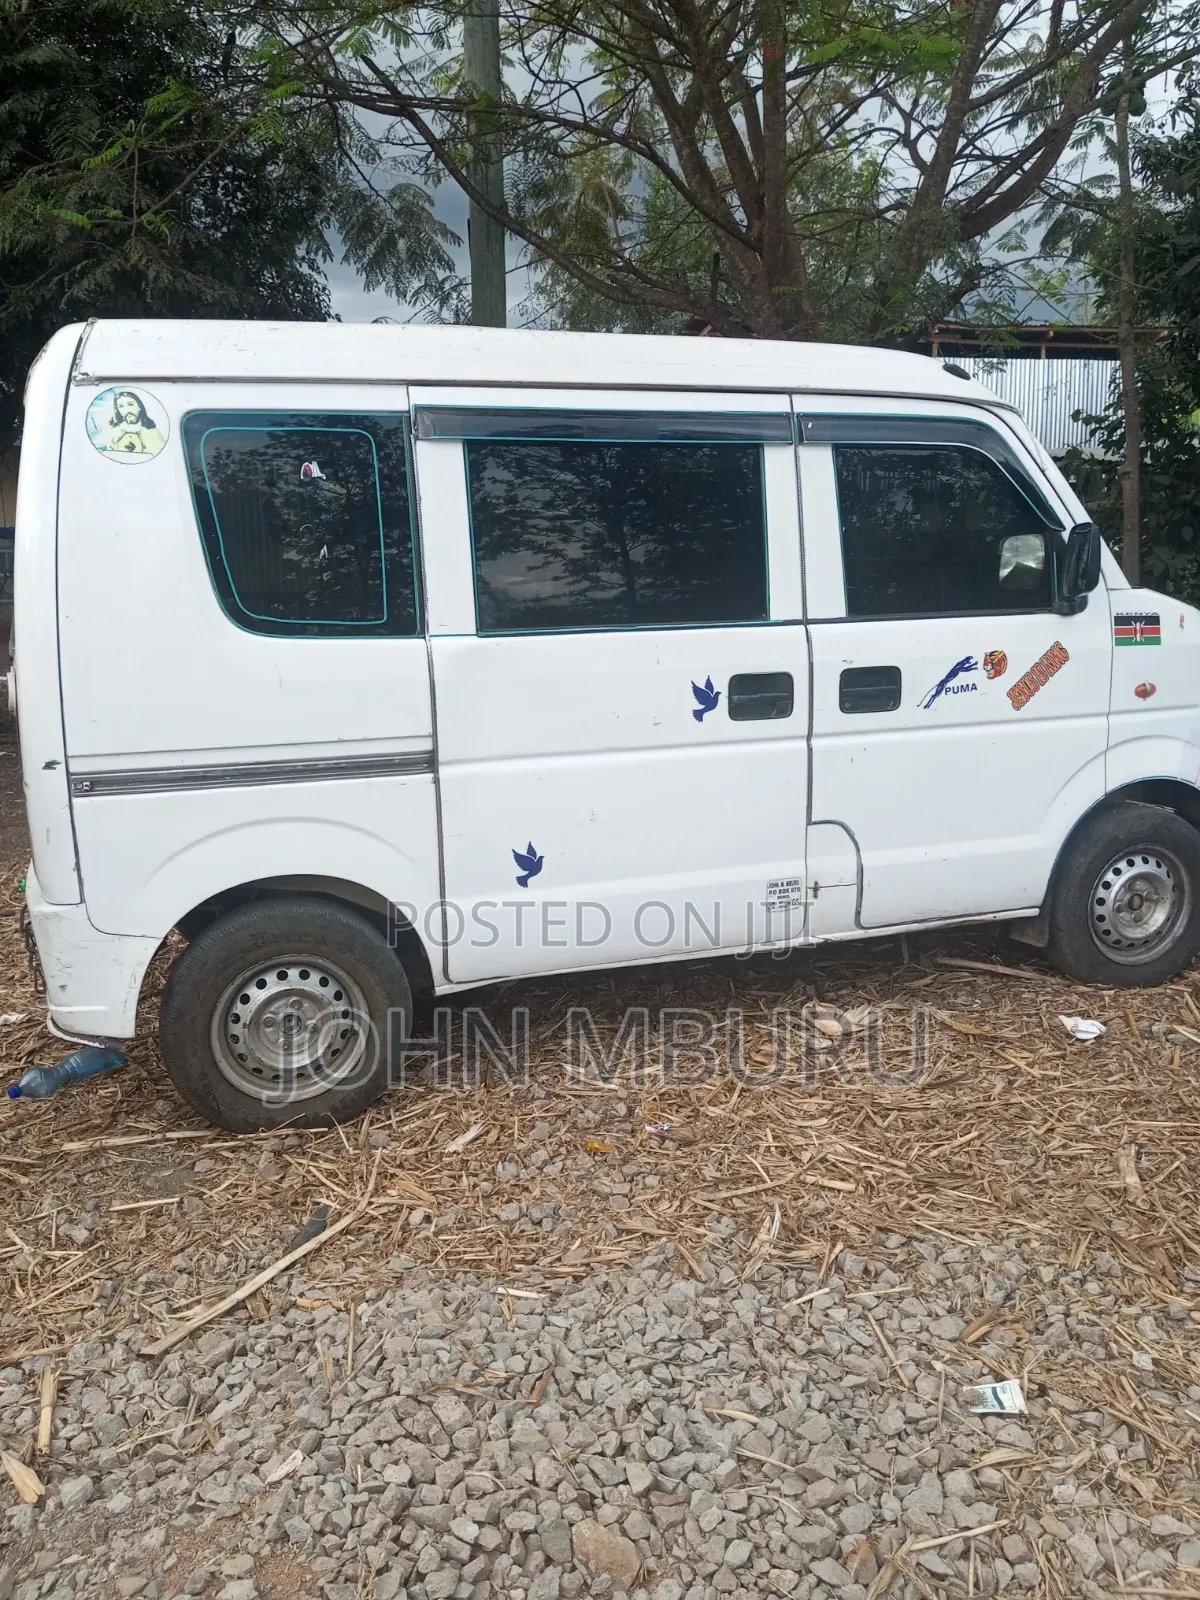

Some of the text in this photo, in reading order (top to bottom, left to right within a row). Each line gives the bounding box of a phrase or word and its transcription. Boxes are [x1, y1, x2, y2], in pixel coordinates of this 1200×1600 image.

[944, 682, 978, 696] PUMA
[1006, 641, 1069, 711] JESUS IS KING
